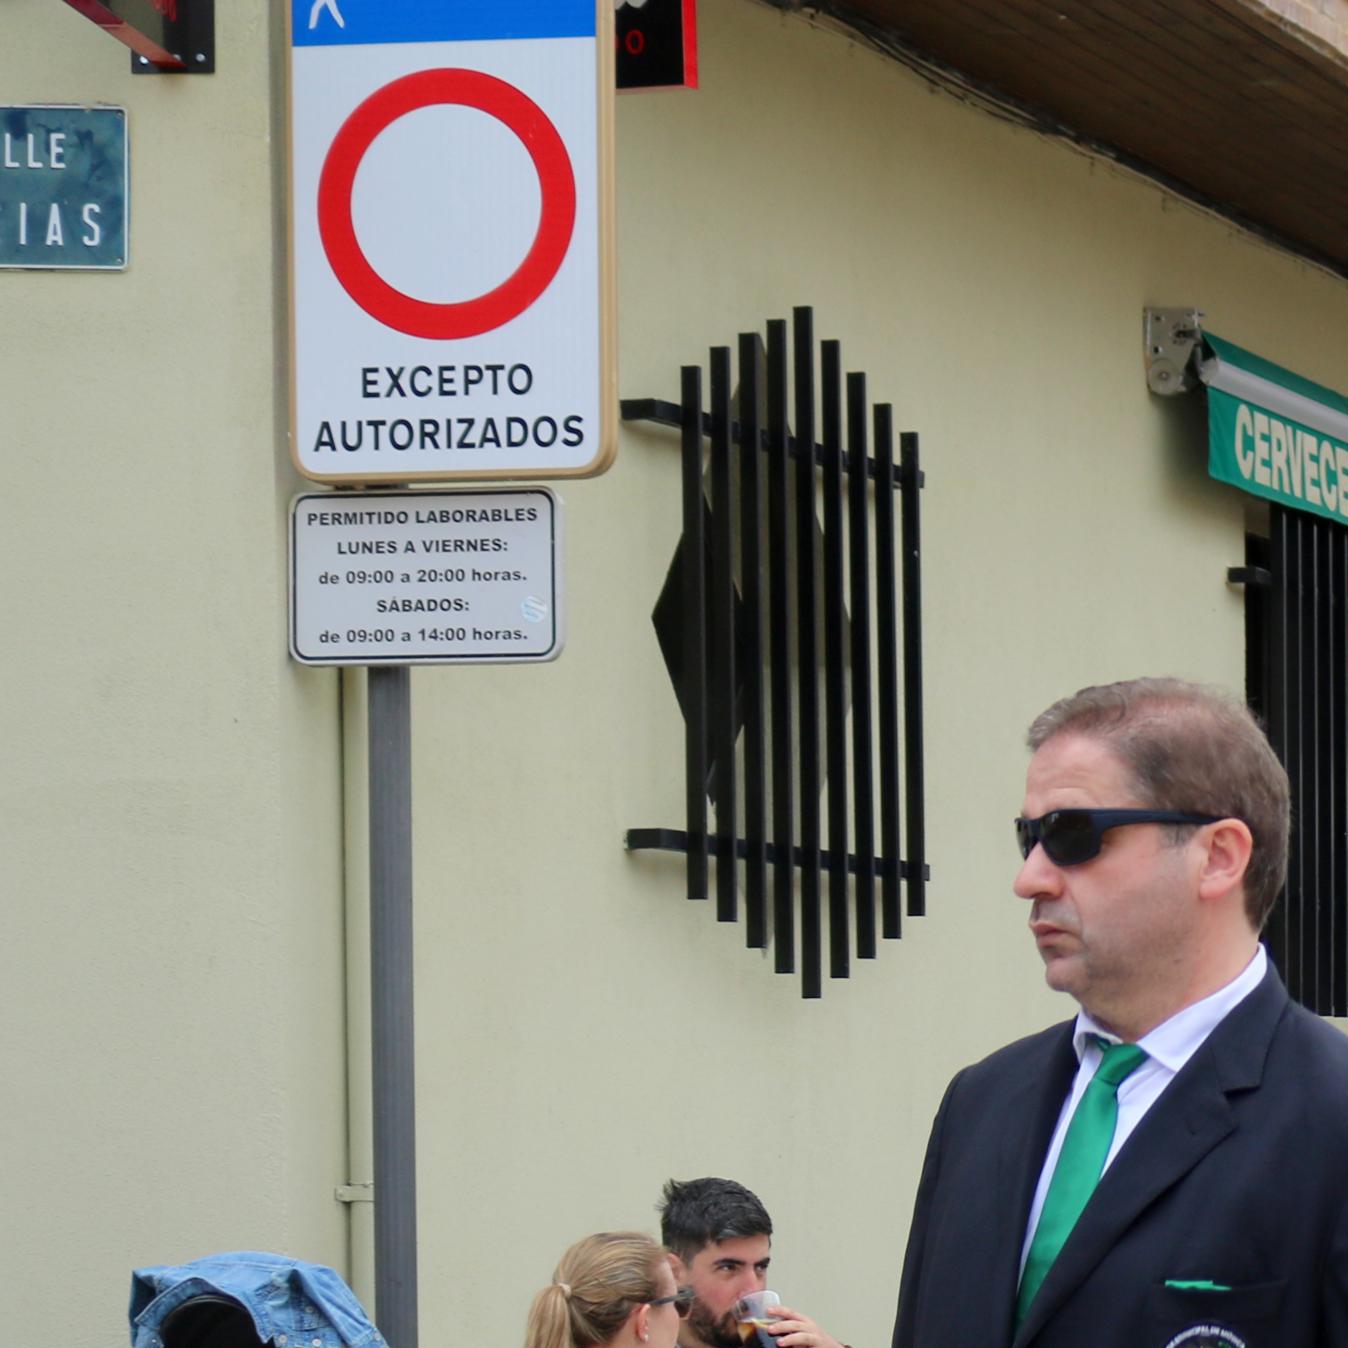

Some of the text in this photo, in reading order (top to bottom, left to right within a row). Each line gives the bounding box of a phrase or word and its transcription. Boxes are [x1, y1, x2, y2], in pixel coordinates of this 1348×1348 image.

[4, 132, 67, 169] LLE
[18, 202, 102, 247] IAS
[361, 362, 534, 399] EXCEPTO
[313, 414, 586, 453] AUTORIZADOS
[307, 507, 538, 526] PERMITIDO LABORABLES
[336, 538, 509, 555] LUNES A VIERNES:
[318, 567, 528, 585] de 09:00 a 20:00 horas.
[376, 596, 470, 613] SÁBADOS:
[318, 626, 529, 644] de 09:00 a 14:00 horas.
